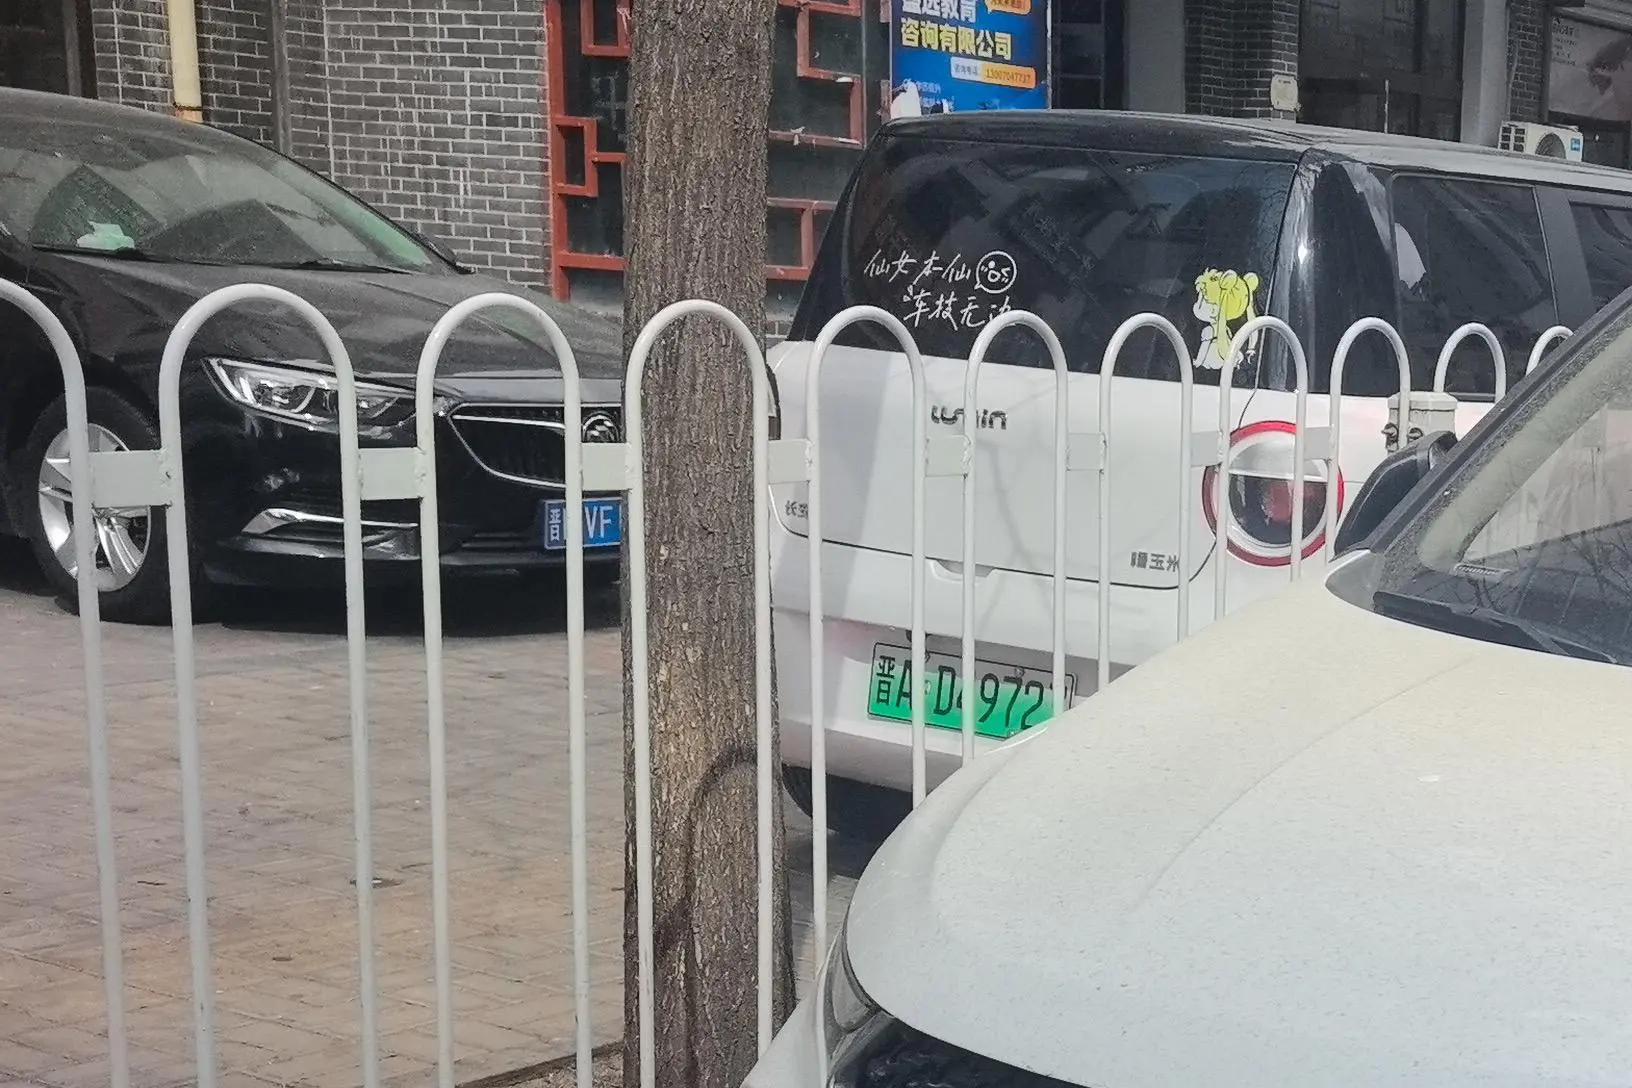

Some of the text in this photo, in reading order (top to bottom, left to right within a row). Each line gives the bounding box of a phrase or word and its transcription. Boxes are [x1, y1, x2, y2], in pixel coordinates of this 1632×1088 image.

[901, 17, 1012, 61] 咨询有限公司
[864, 249, 972, 285] 仙女本仙
